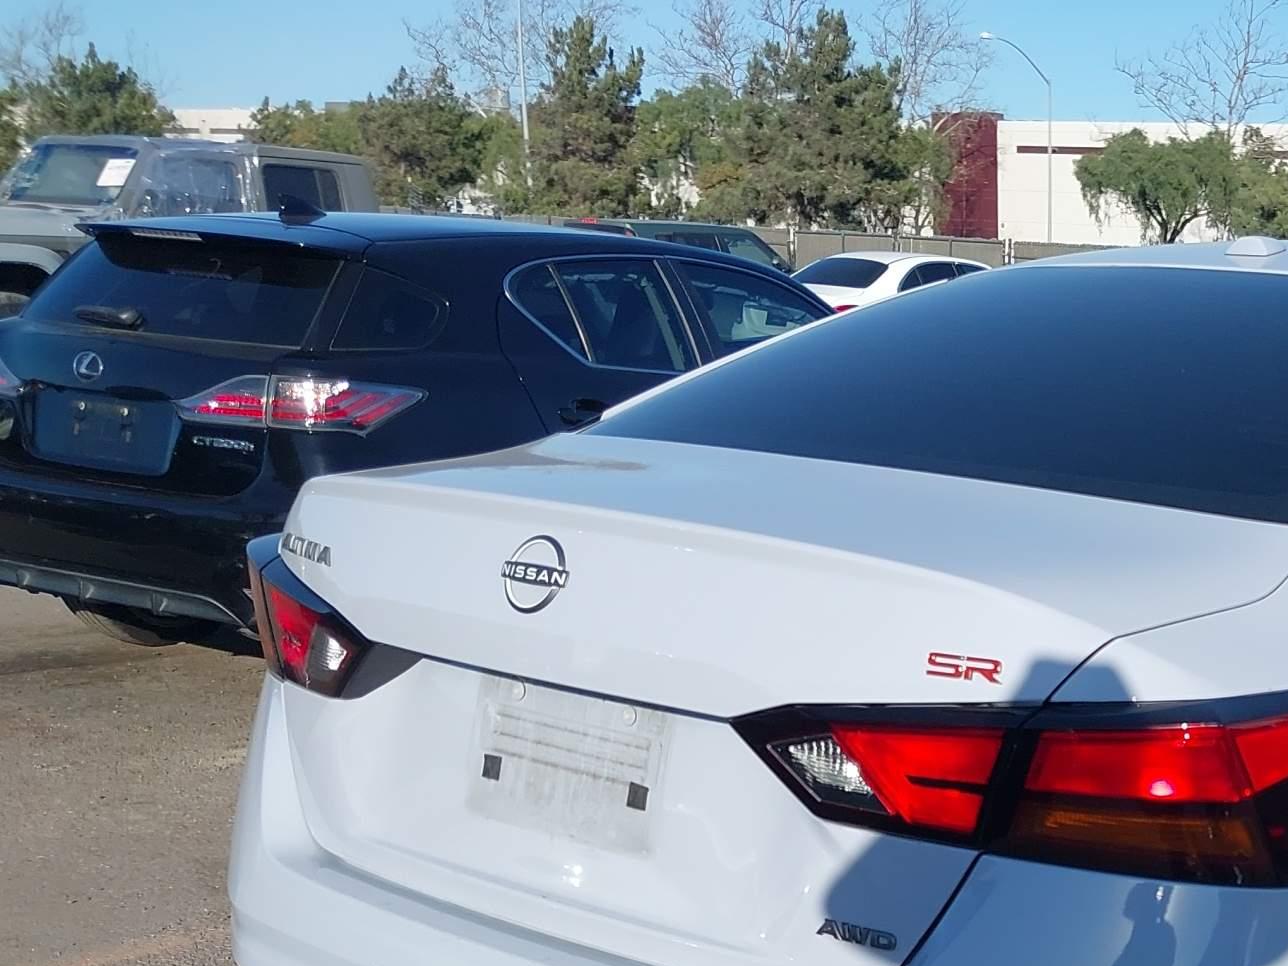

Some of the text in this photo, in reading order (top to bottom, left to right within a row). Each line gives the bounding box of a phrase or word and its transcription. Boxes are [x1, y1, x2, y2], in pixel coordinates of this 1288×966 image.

[502, 563, 567, 586] NISSAN
[926, 652, 1003, 685] SR
[816, 918, 897, 951] AWD
